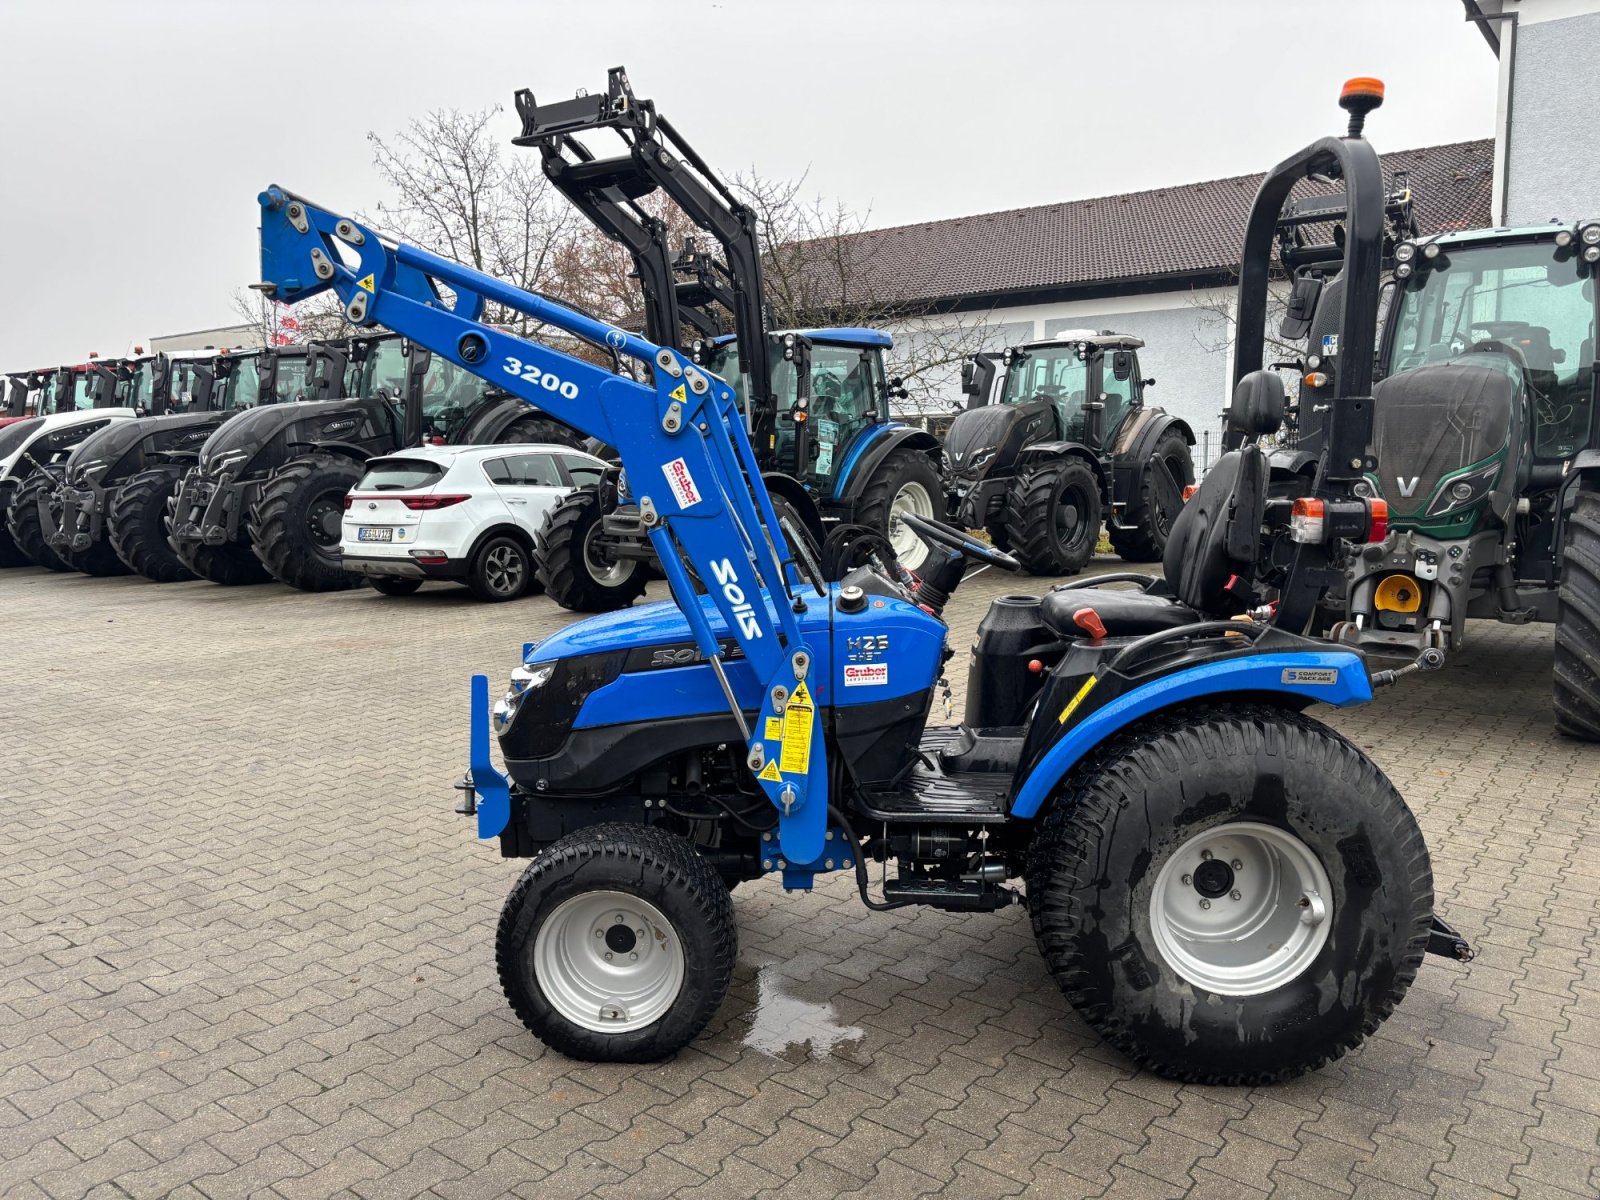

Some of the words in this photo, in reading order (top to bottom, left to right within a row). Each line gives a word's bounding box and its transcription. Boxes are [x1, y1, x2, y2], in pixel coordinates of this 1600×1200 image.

[502, 356, 579, 400] 3200
[672, 461, 697, 504] Gruber
[1396, 476, 1420, 497] V
[846, 666, 886, 677] Gruber
